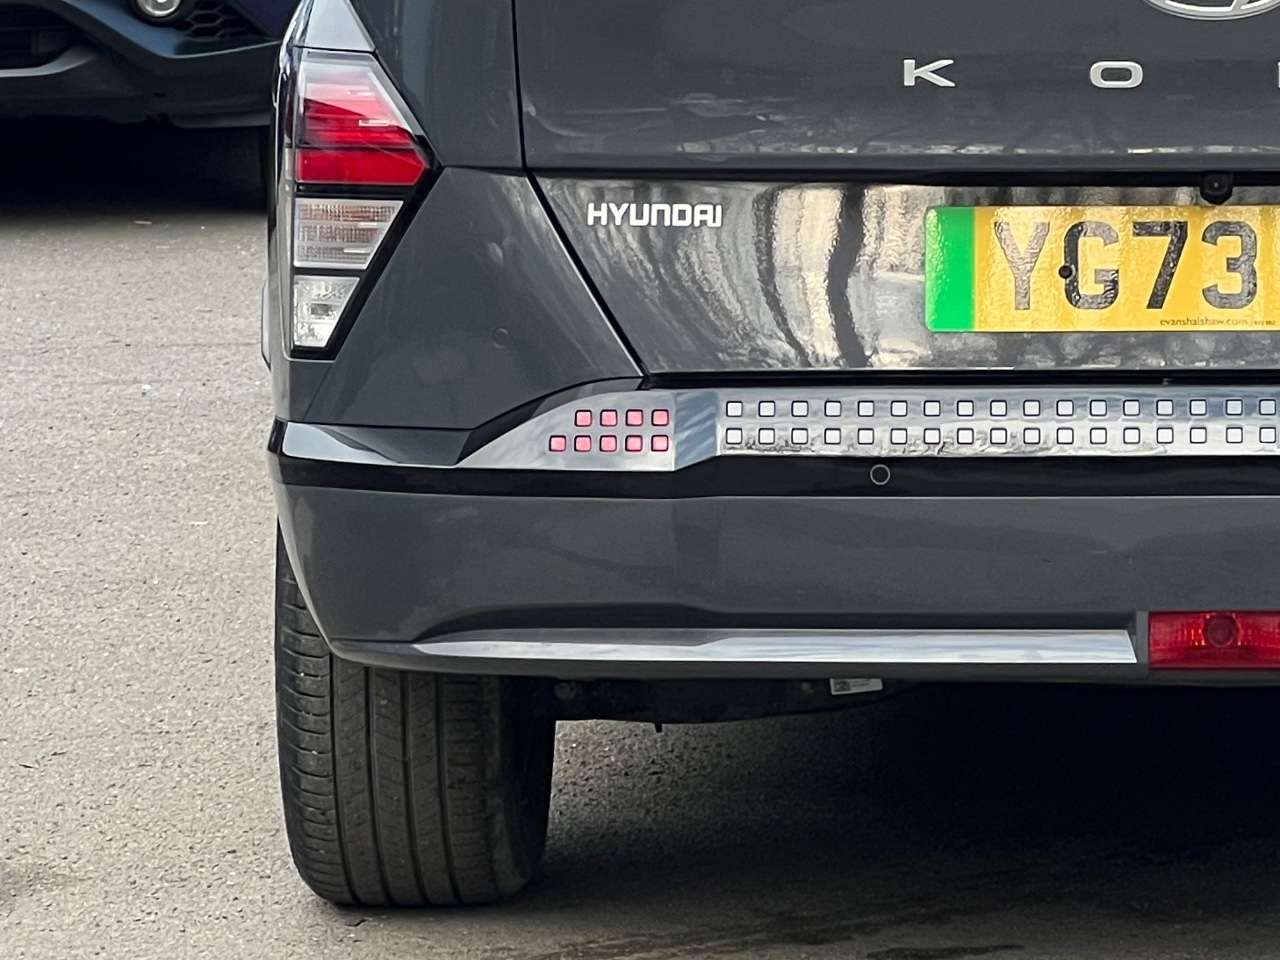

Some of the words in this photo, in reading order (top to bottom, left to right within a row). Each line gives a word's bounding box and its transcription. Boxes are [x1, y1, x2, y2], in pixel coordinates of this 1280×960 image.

[586, 202, 723, 228] HYUNDAI
[992, 219, 1259, 311] YG73
[1159, 316, 1249, 327] evanshalshaw.com
